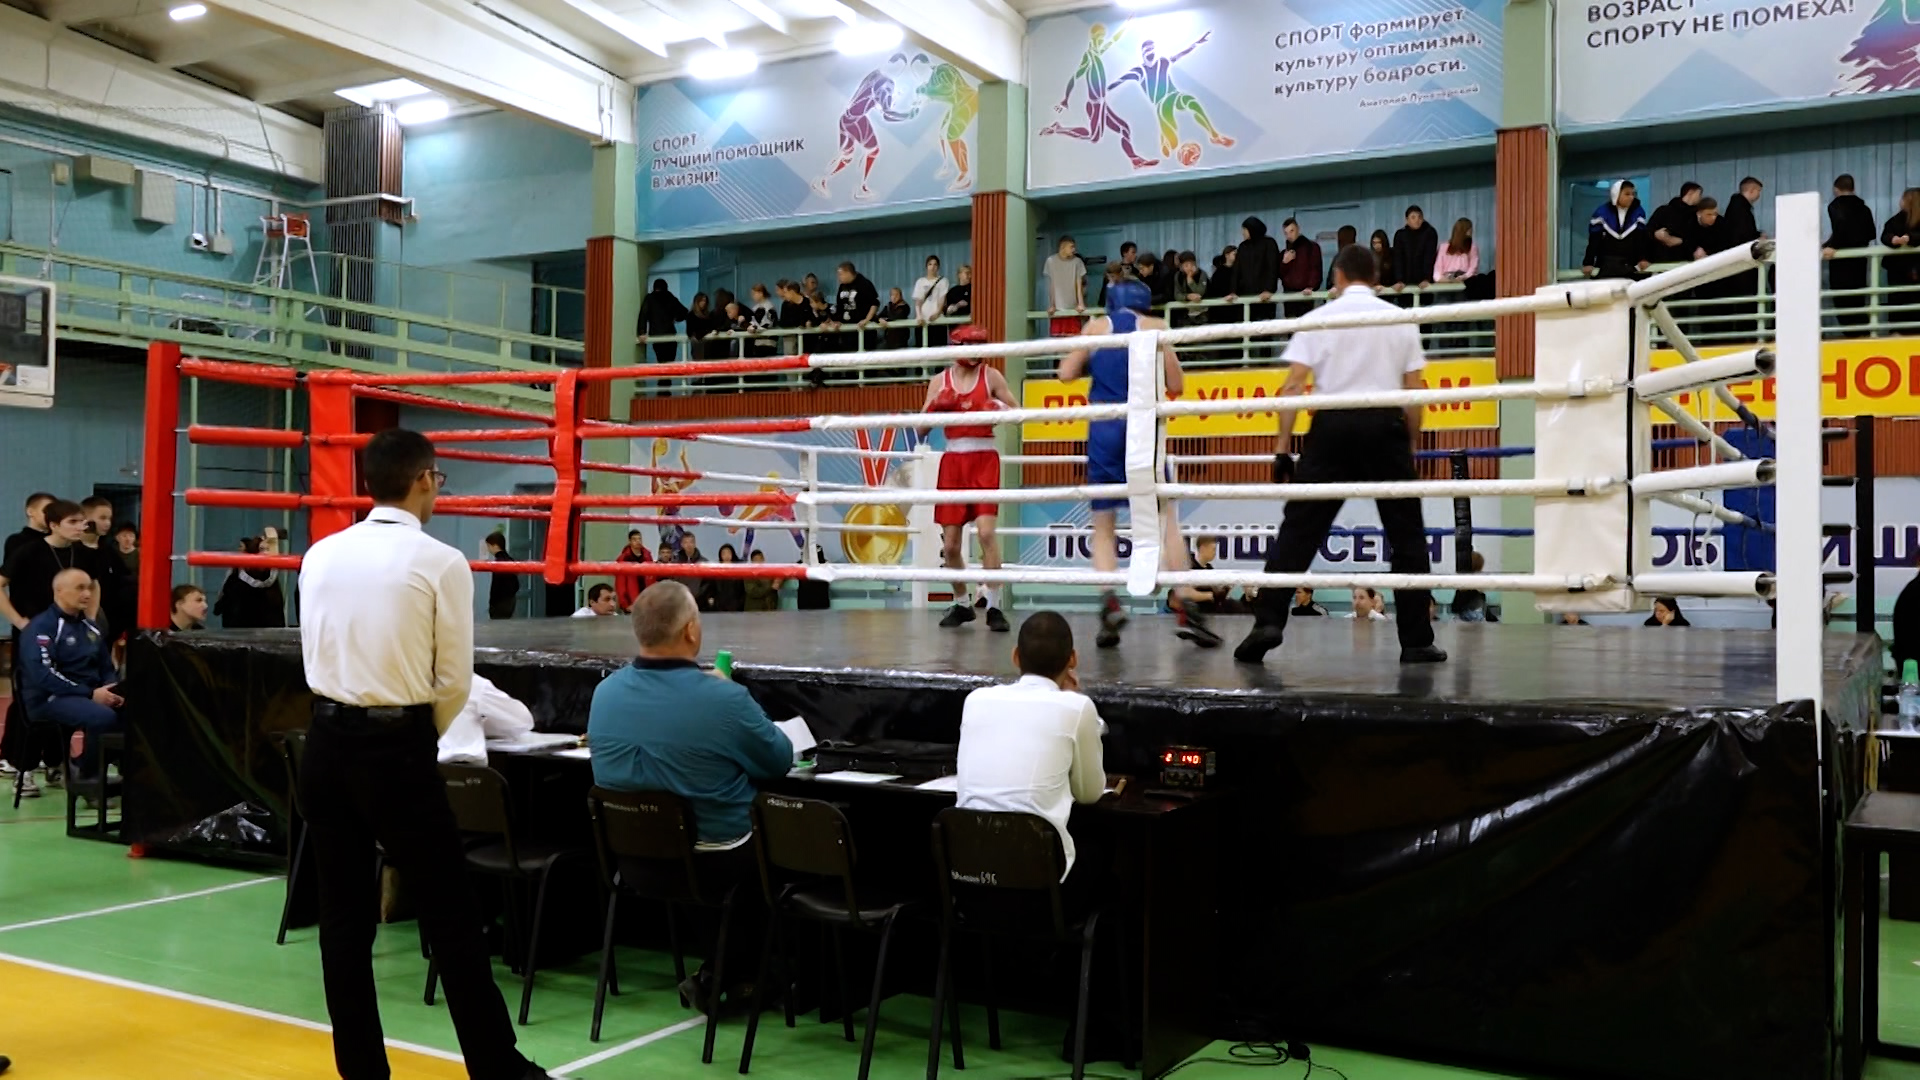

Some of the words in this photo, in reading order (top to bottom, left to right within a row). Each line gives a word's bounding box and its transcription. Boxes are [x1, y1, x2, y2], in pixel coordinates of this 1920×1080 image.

[1275, 23, 1344, 49] СПОРТ
[1350, 9, 1463, 41] формирует
[1587, 19, 1687, 48] СПОРТУ
[1693, 13, 1724, 34] НЕ
[1733, 0, 1854, 28] ПОМЕХА!
[1275, 51, 1358, 76] культуру
[1275, 75, 1358, 98] культуру
[1363, 60, 1466, 84] бодрости.
[652, 147, 712, 170] ЛУЧШИЙ
[715, 138, 805, 162] ПОМОЩНИК
[653, 133, 697, 152] СПОРТ
[652, 177, 660, 188] В
[664, 171, 719, 188] ЖИЗНИ!
